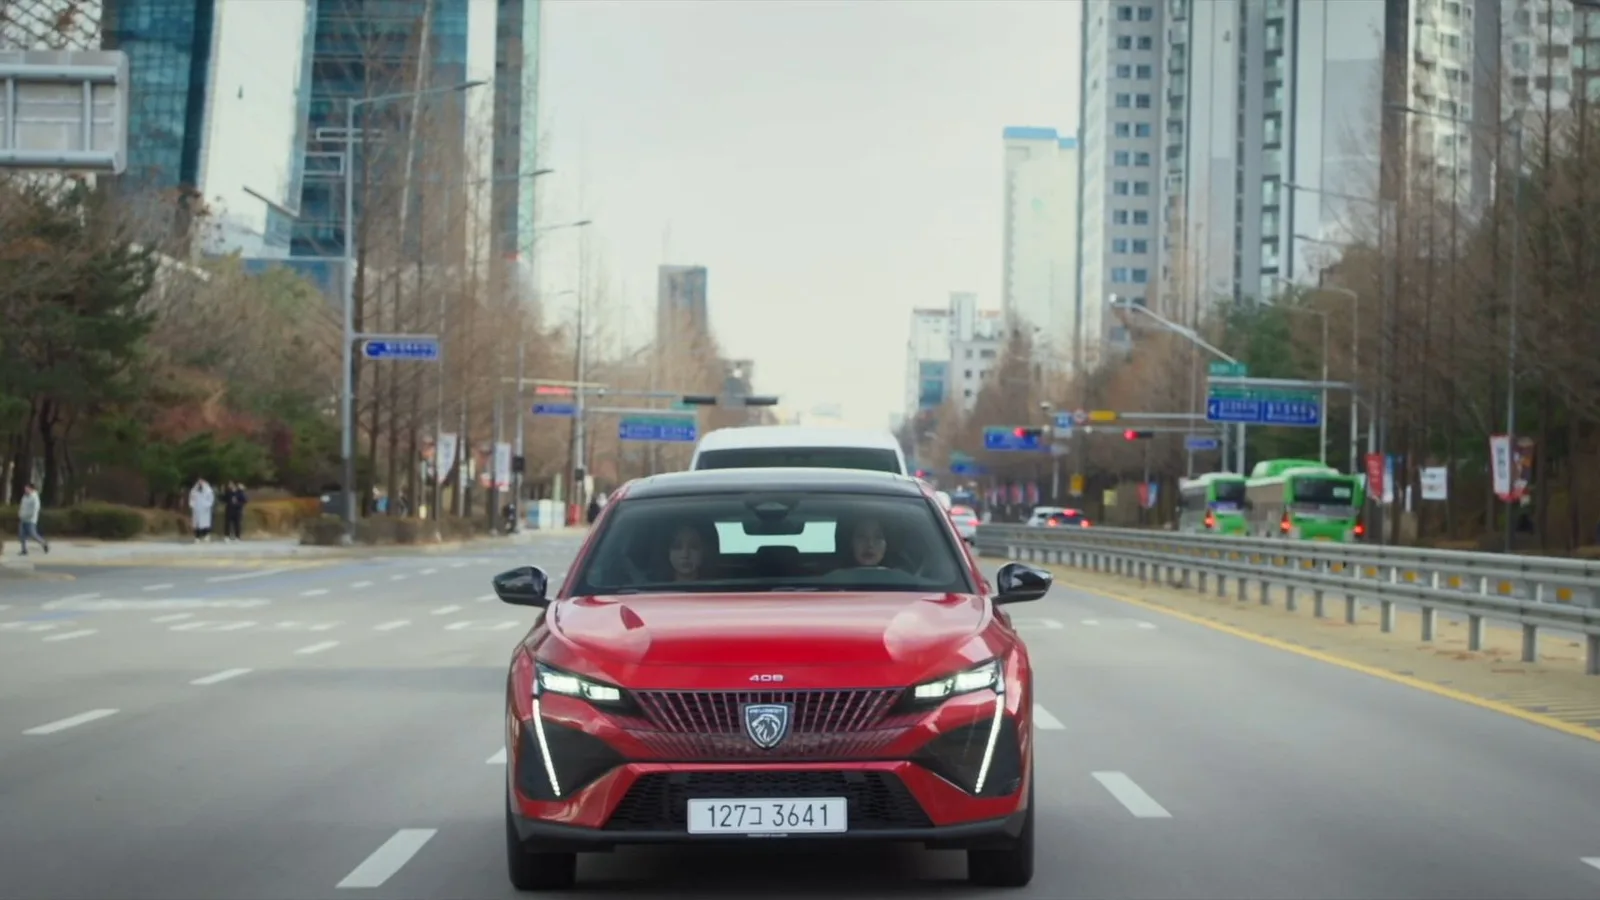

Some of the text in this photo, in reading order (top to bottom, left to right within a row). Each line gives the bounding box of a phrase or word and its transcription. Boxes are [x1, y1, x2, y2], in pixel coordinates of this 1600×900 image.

[749, 674, 784, 682] 408
[707, 803, 828, 828] 127그 3641
